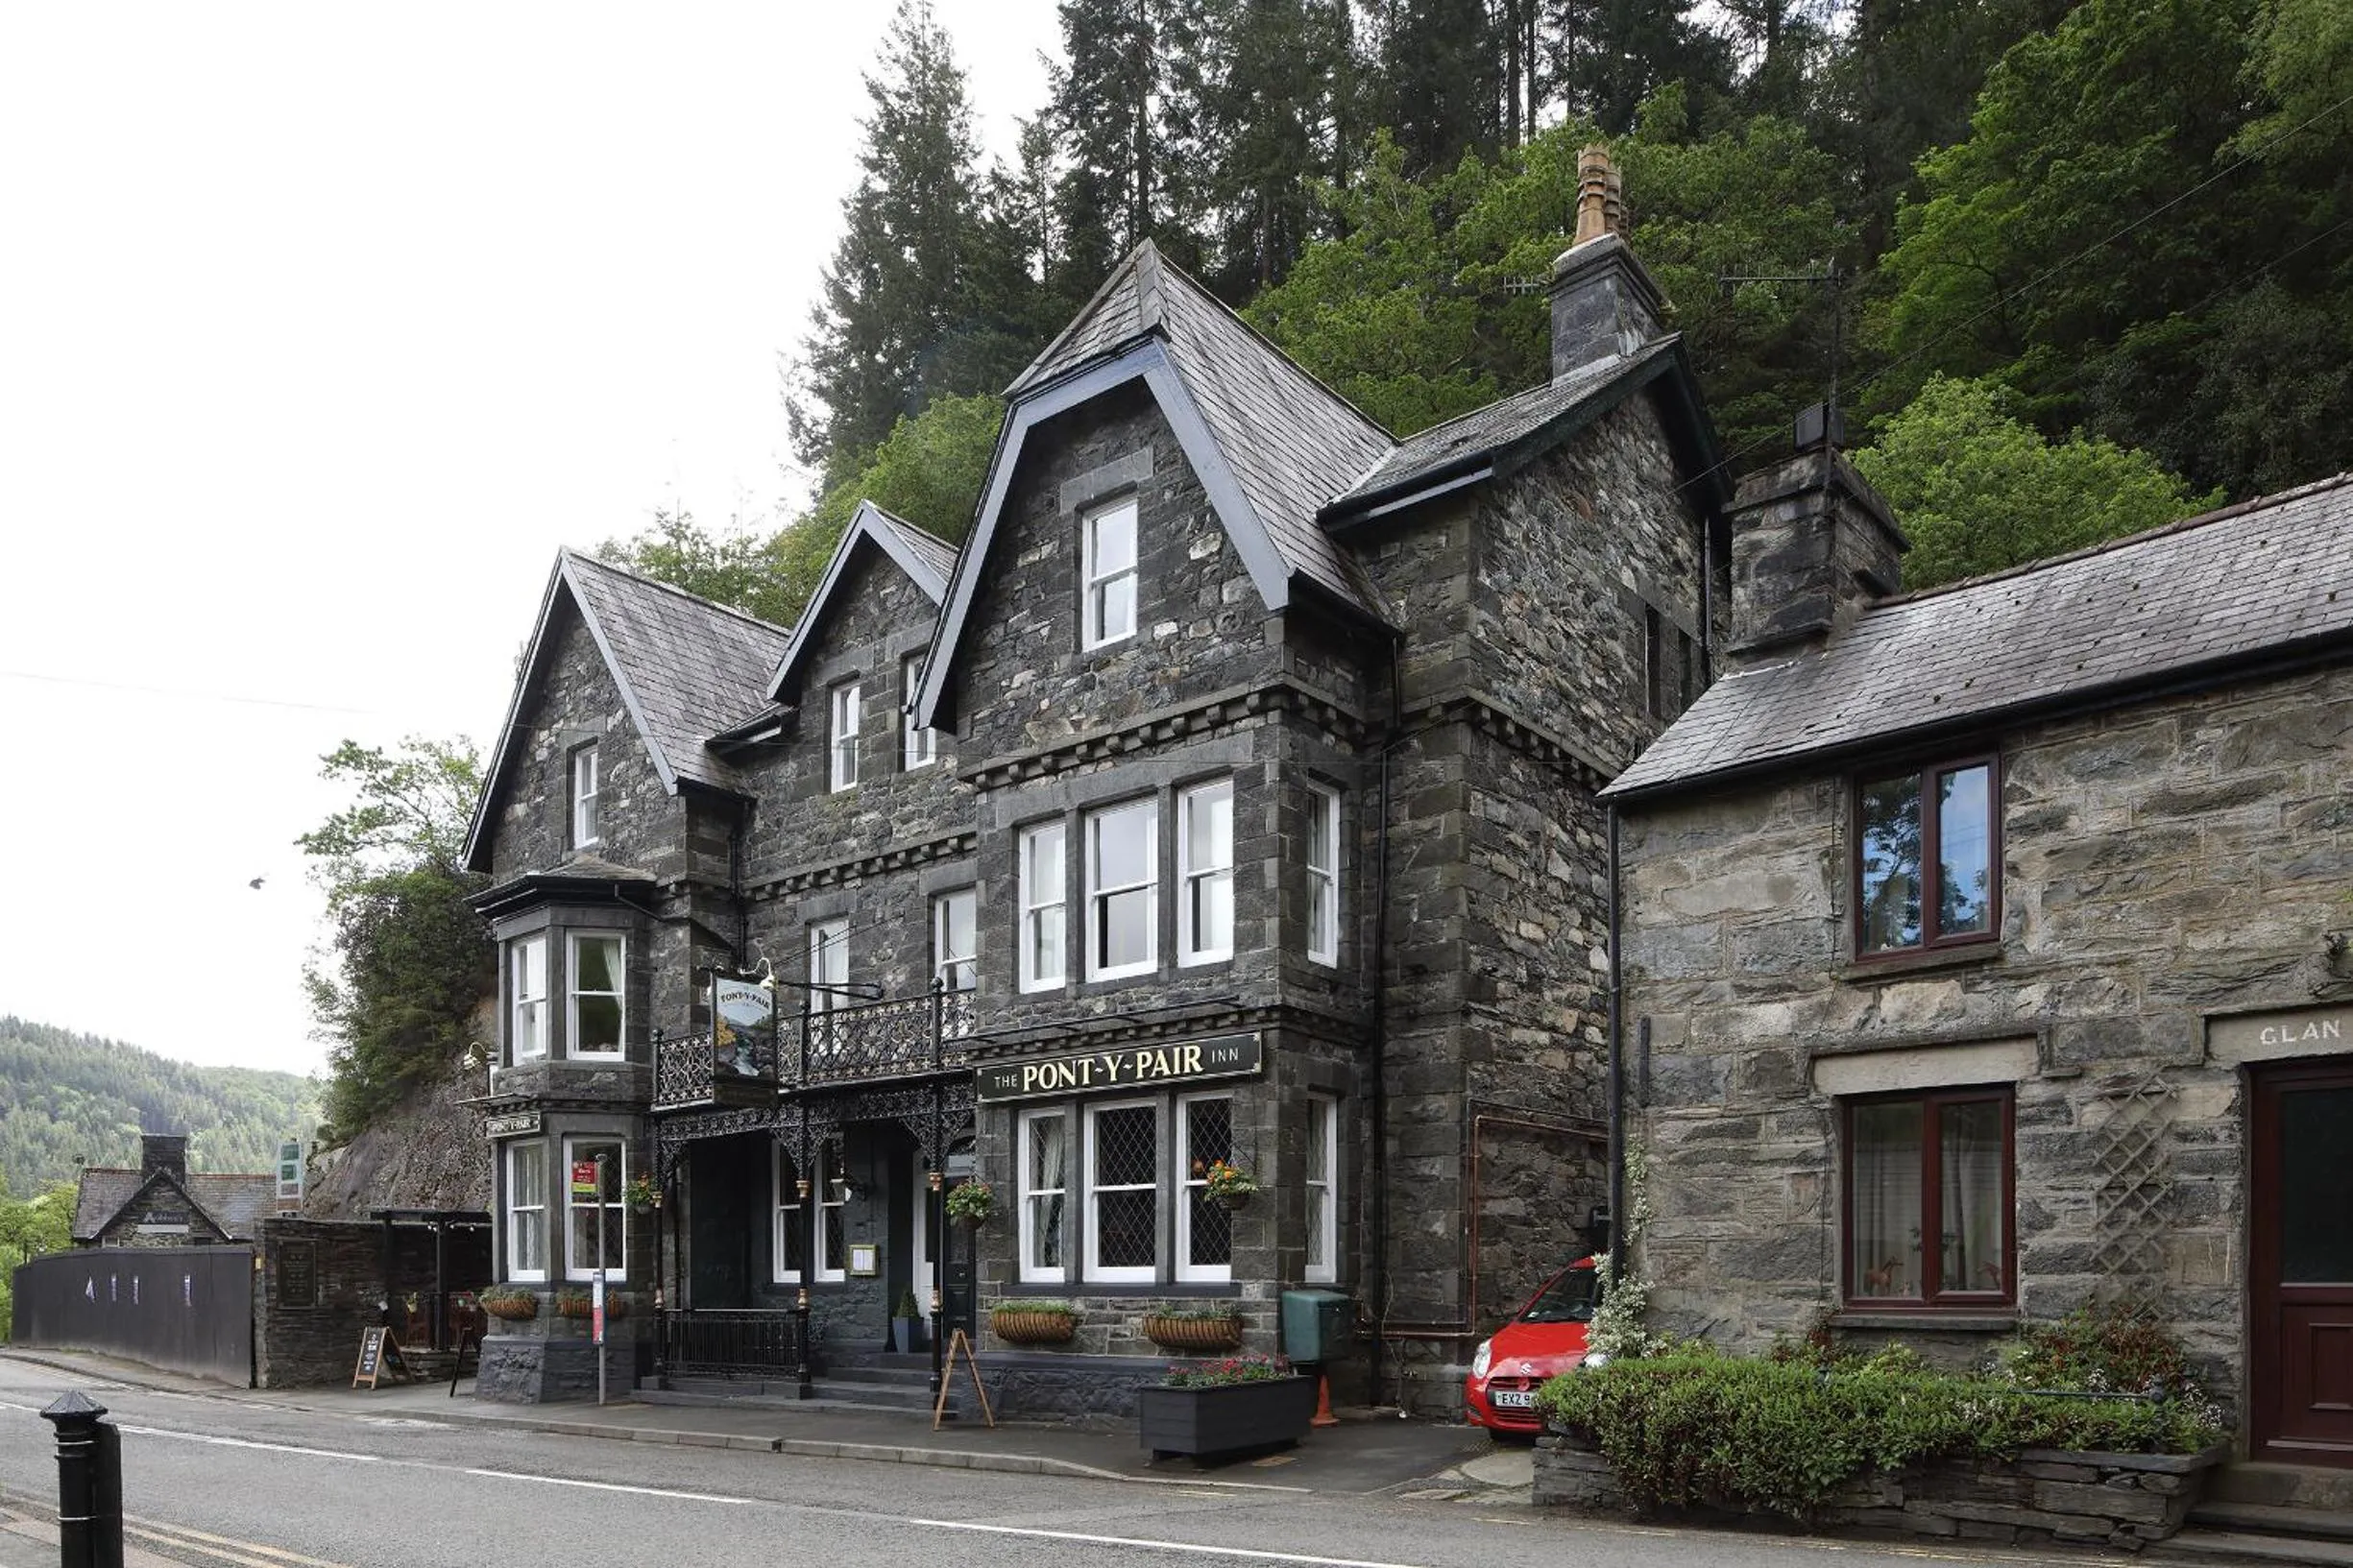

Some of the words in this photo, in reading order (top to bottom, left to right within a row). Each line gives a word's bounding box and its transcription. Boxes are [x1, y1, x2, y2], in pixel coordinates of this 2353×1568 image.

[2260, 1020, 2341, 1046] GLAN
[994, 1073, 1018, 1090] THE
[1211, 1047, 1239, 1064] INN
